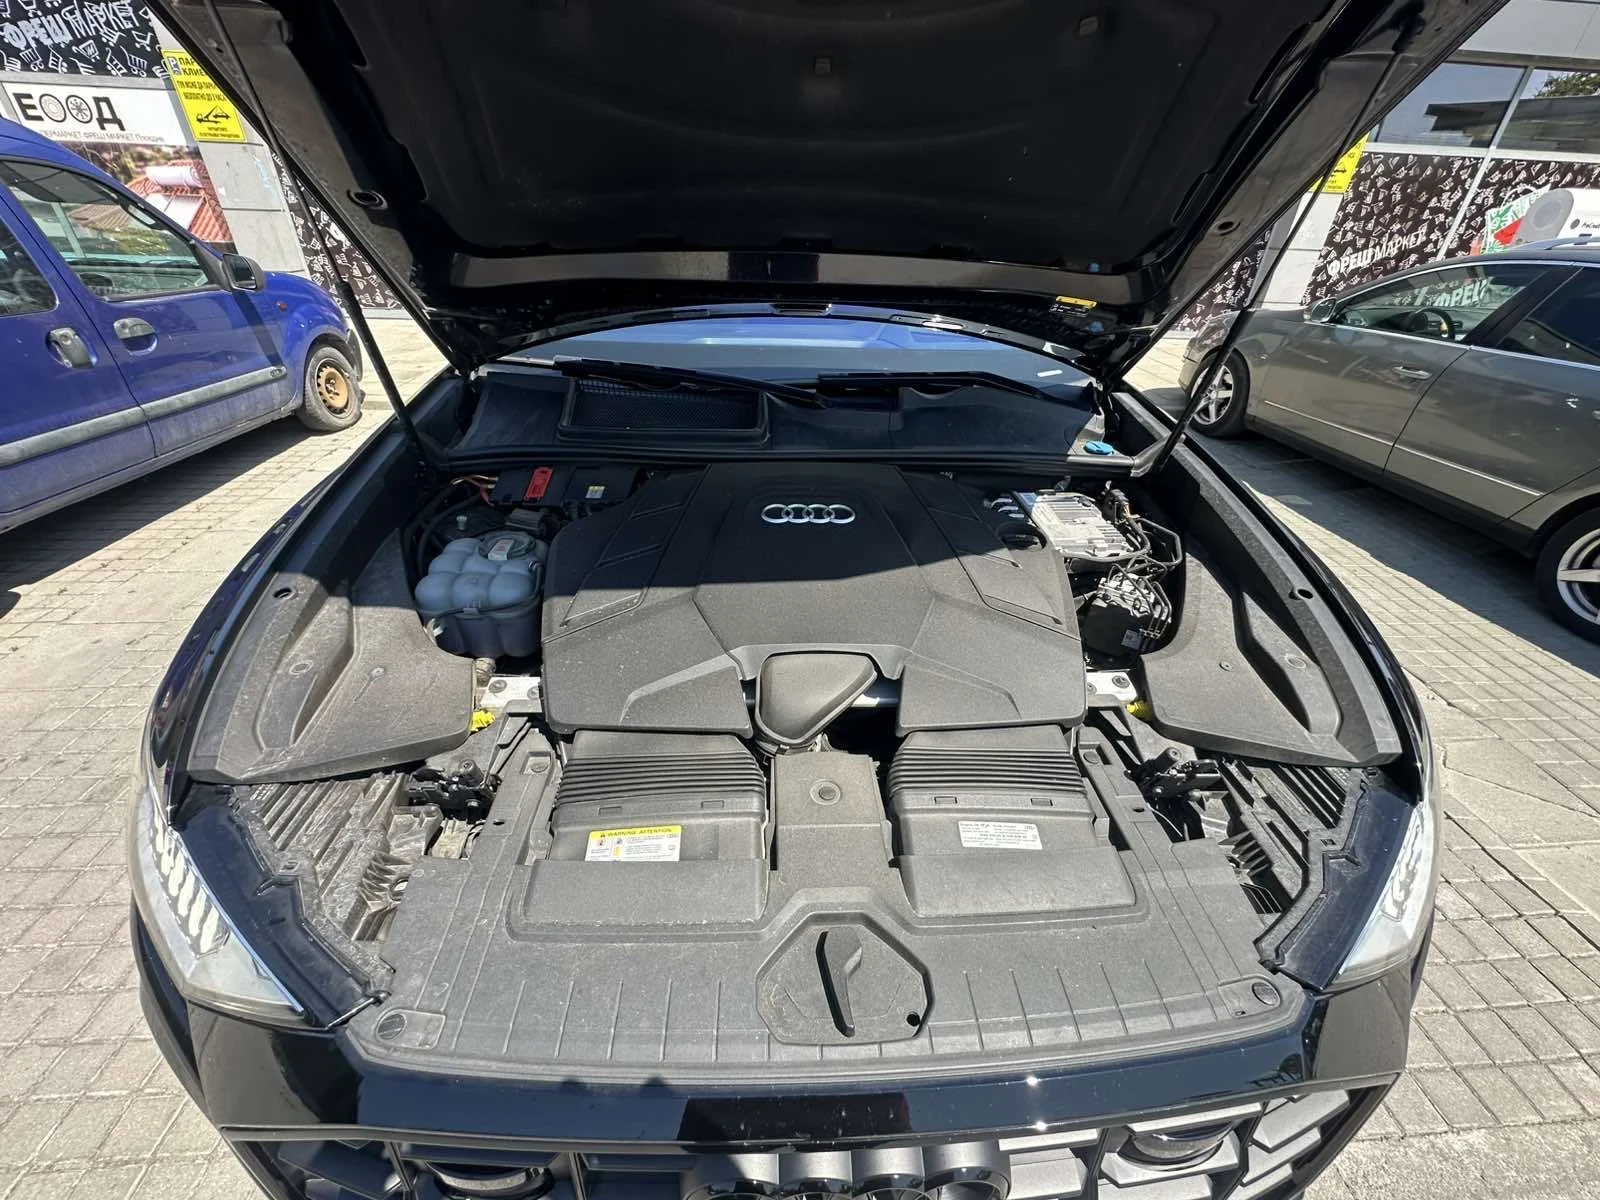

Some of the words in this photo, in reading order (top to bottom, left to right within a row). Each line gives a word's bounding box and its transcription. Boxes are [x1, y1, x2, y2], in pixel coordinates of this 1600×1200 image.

[4, 14, 74, 50] ФРЕШ
[65, 1, 139, 39] МАРКЕТ
[179, 58, 195, 66] ПАР
[182, 68, 205, 76] КЛИЕ
[1327, 247, 1374, 277] ФРЕШ
[1373, 229, 1427, 262] МАРКЕТ
